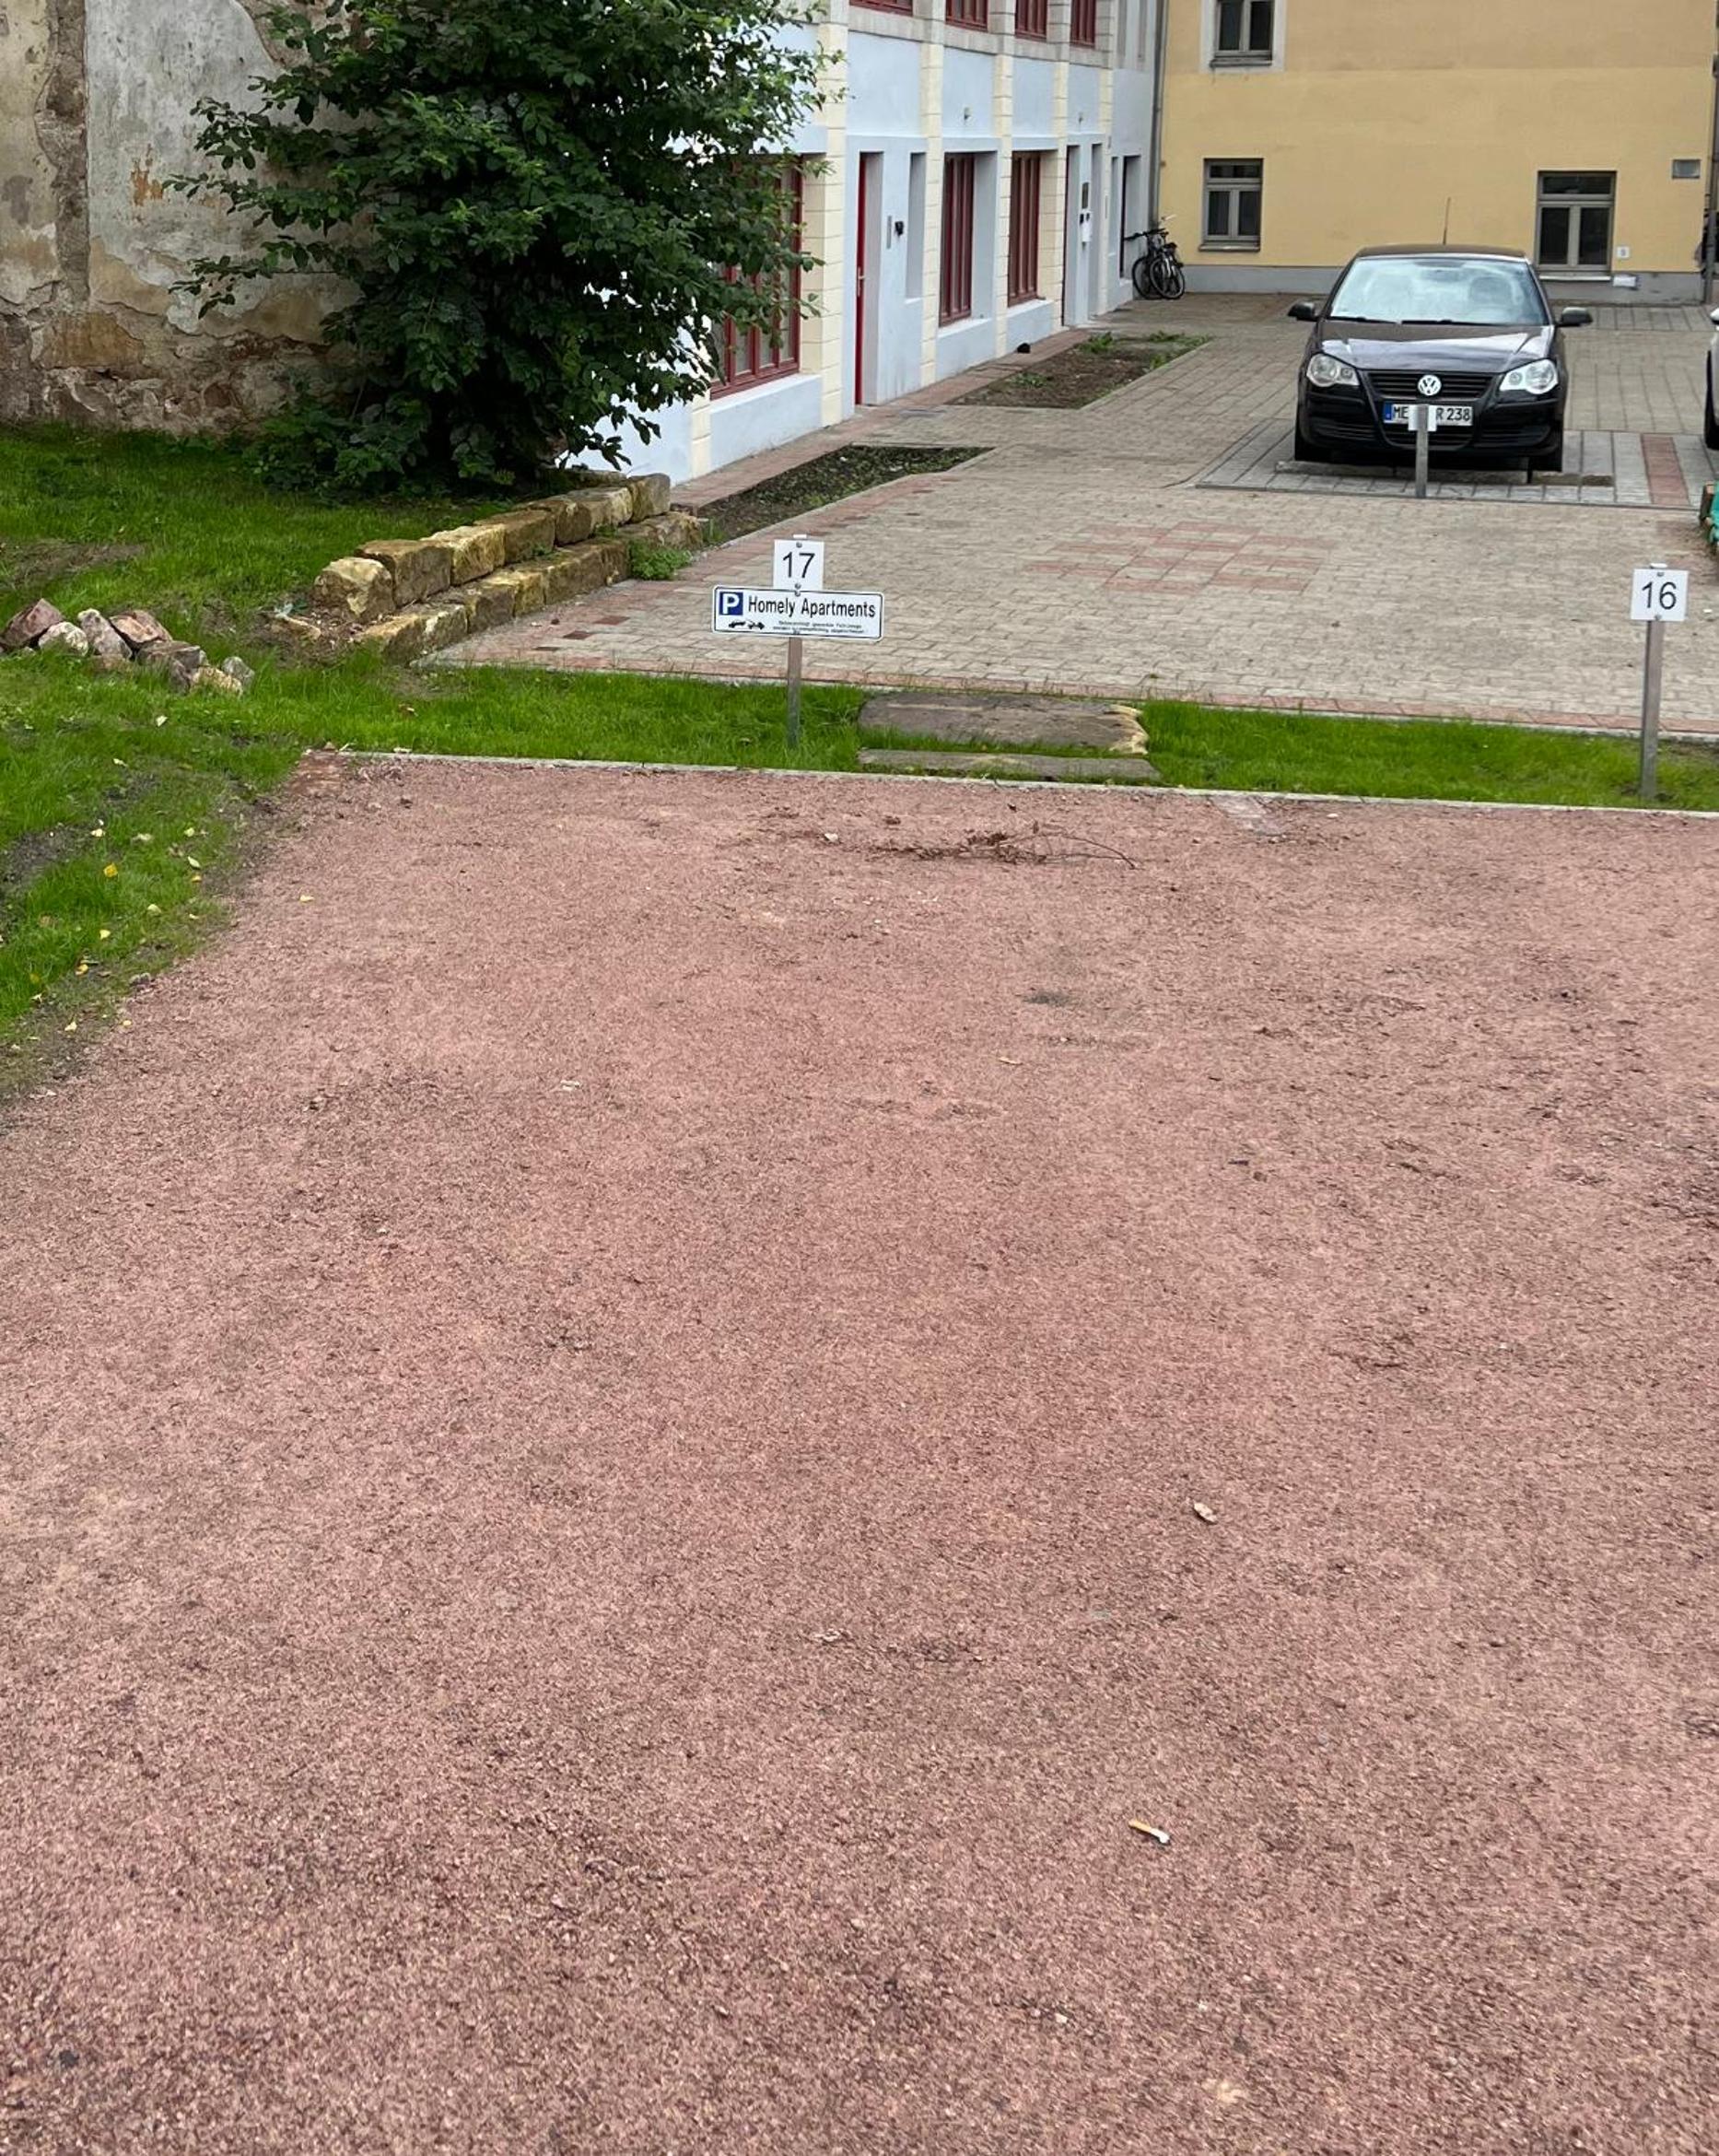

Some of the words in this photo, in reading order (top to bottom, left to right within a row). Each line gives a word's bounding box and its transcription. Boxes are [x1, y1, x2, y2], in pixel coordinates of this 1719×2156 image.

[1446, 407, 1470, 421] 238
[782, 551, 815, 579] 17
[722, 592, 740, 615] P
[748, 595, 796, 617] Homely
[801, 598, 876, 618] Apartments
[1642, 581, 1677, 610] 16
